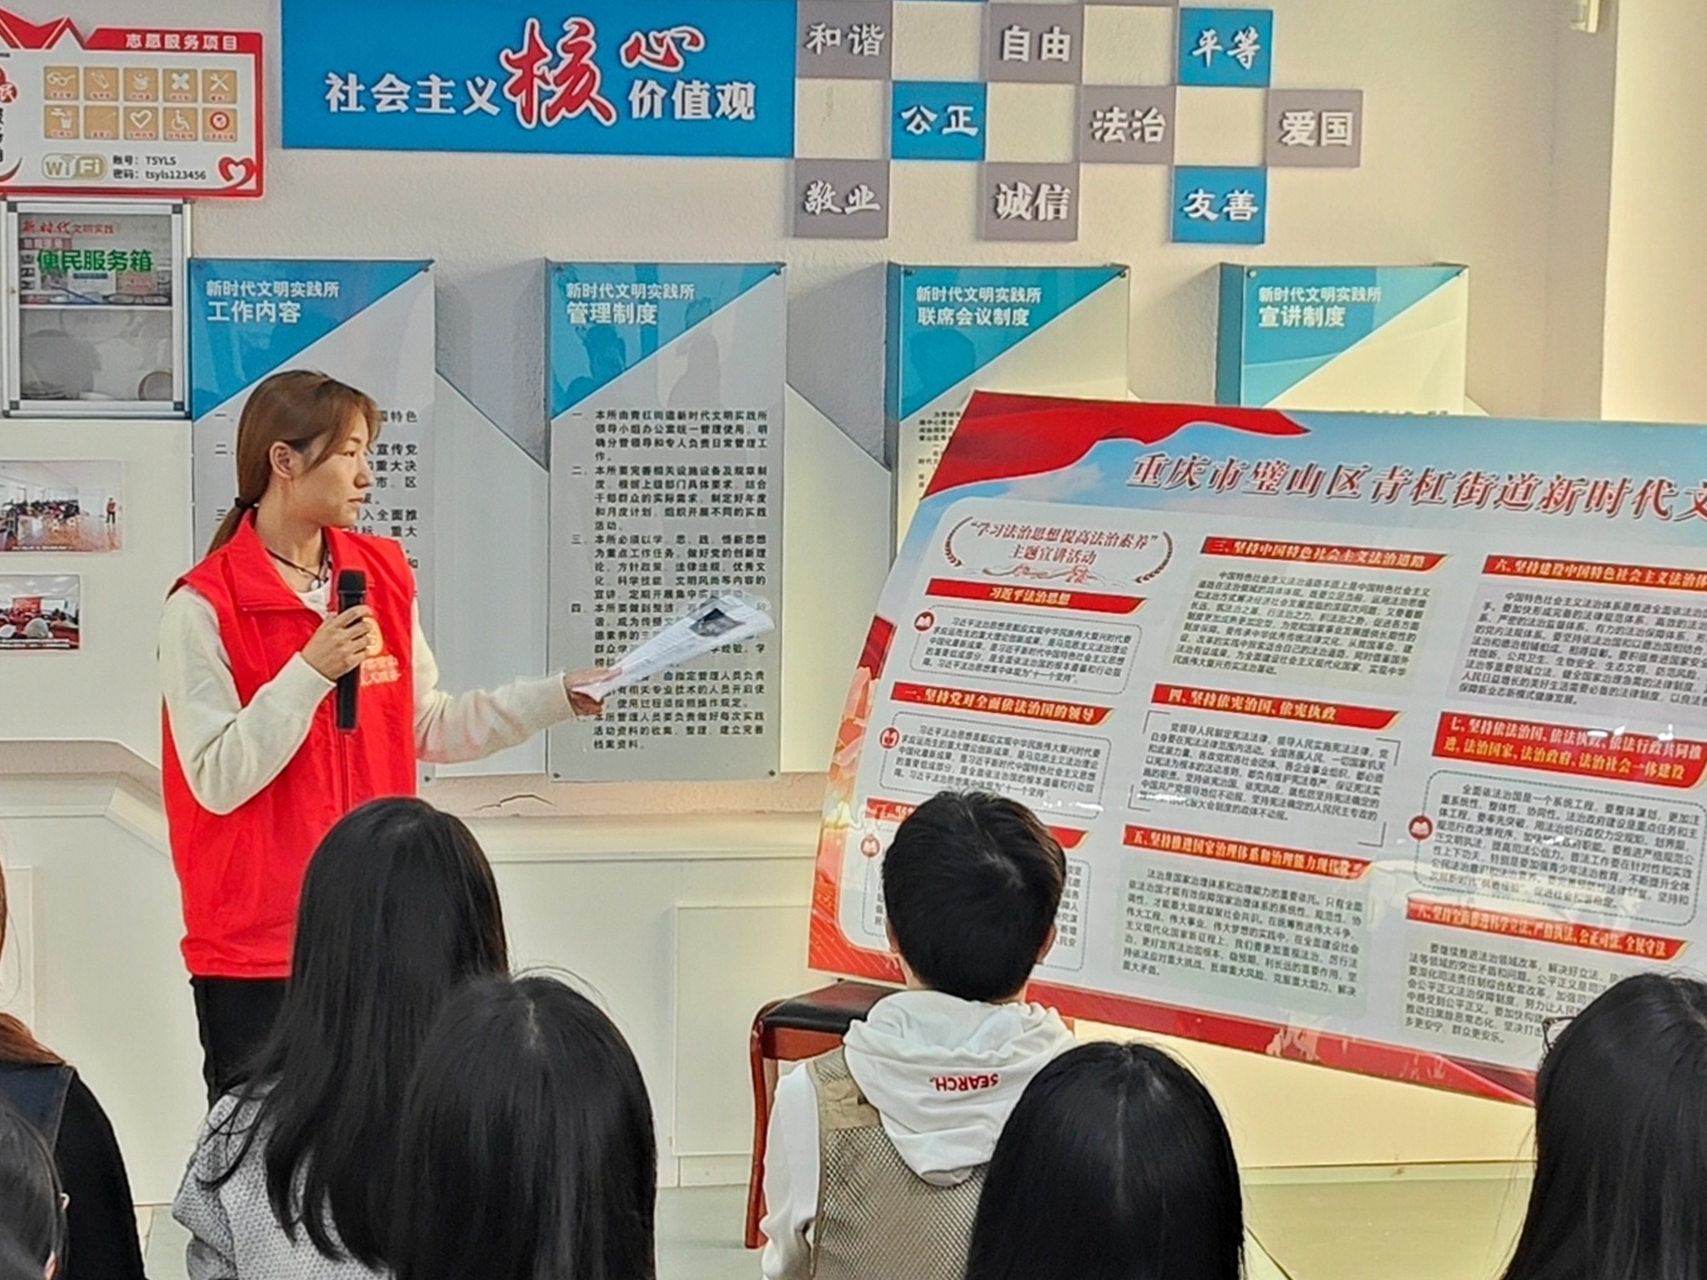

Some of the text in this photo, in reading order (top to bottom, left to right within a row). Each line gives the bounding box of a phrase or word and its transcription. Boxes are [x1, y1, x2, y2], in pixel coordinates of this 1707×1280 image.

[126, 33, 238, 51] 志愿服务项目
[807, 21, 887, 62] 和谐
[1003, 23, 1074, 64] 自由
[1190, 28, 1262, 72] 平等
[903, 102, 977, 140] 公正
[1093, 105, 1168, 146] 法治
[1281, 109, 1354, 151] 爱国
[802, 178, 884, 219] 敬业
[996, 178, 1074, 224] 诚信
[1182, 185, 1257, 227] 友善
[36, 249, 154, 272] 便民服务箱
[206, 280, 339, 298] 新时代文明实践所
[566, 283, 695, 300] 新时代文明实践所
[916, 286, 1041, 304] 新时代文明实践所
[1259, 286, 1382, 303] 新时代文明实践所
[207, 301, 302, 323] 工作内容
[567, 302, 658, 325] 管理制度
[918, 306, 1030, 327] 联席会议制度
[1259, 305, 1346, 328] 宣讲制度
[1009, 545, 1097, 565] 主题宣讲活动
[1212, 540, 1426, 568] 三、坚持中国特色社会主义法治道路
[990, 586, 1072, 605] 习近平法治思想
[1168, 688, 1336, 721] 四、坚持依宪治国、依宪执政
